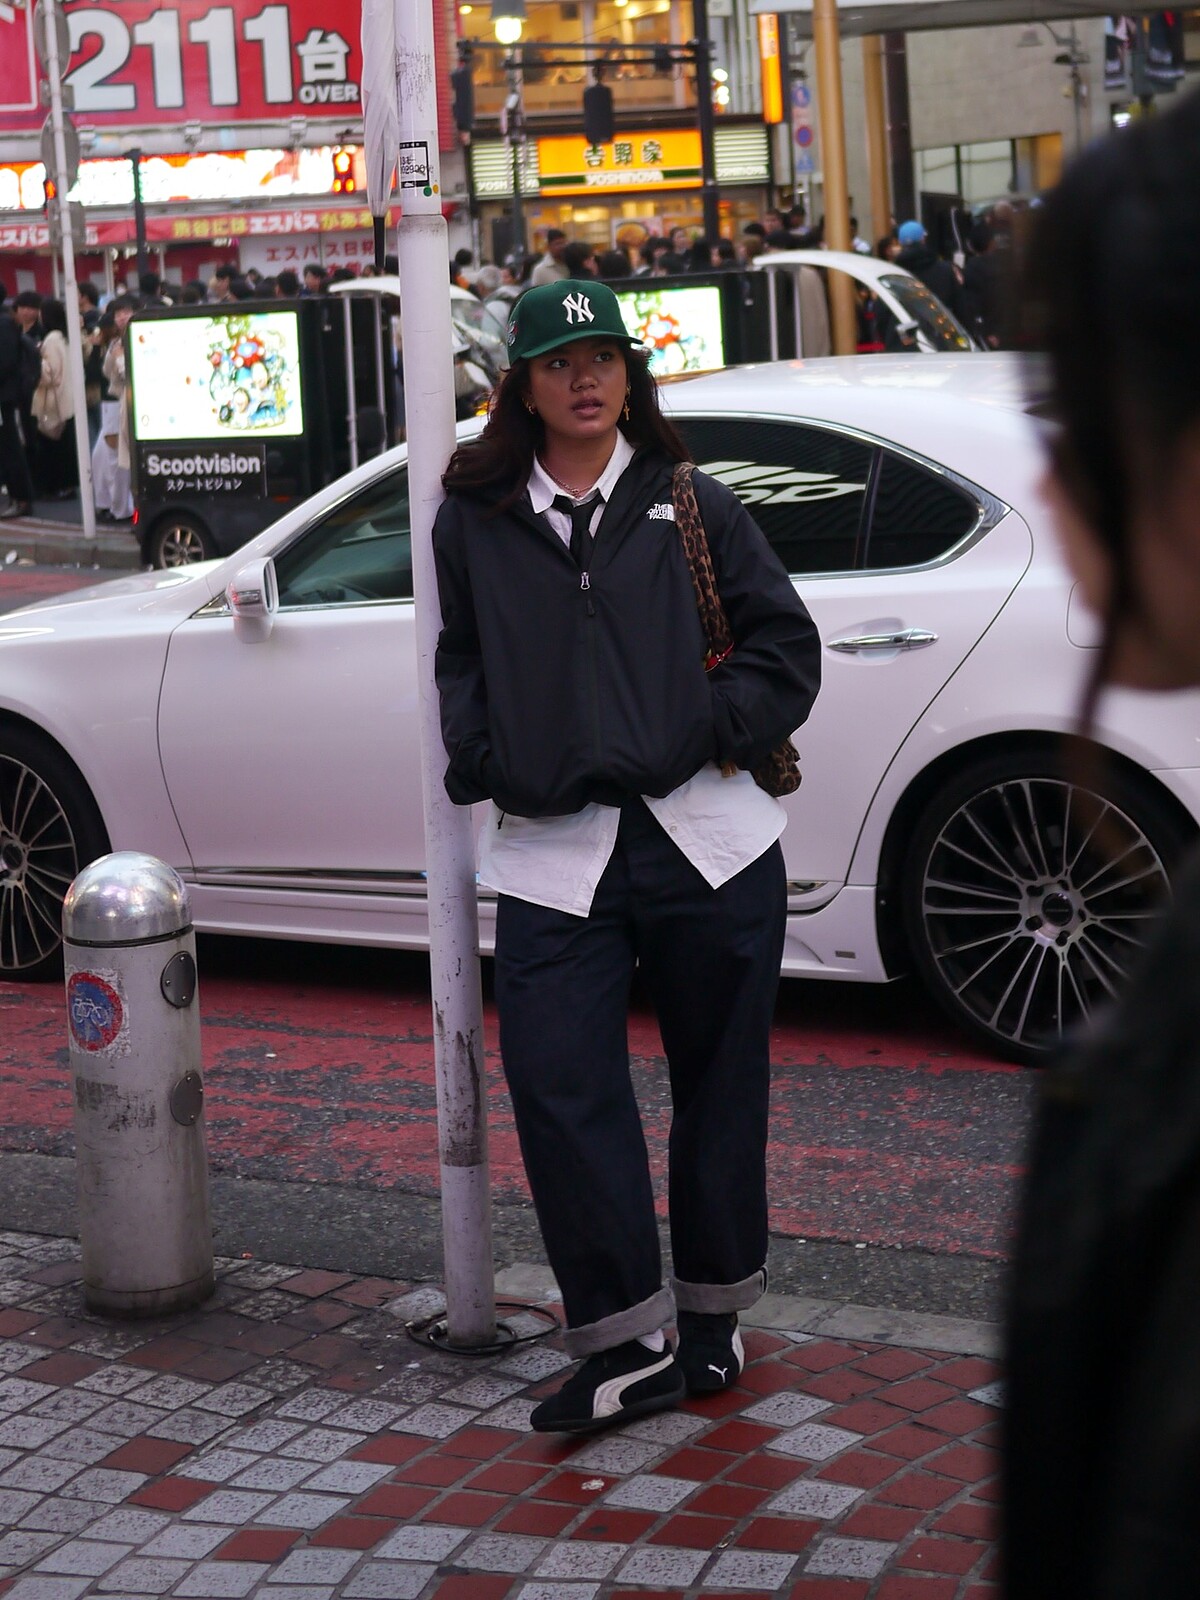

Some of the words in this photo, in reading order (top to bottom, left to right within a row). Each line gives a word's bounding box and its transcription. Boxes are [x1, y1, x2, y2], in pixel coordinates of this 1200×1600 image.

[299, 83, 358, 104] OVER
[585, 141, 664, 168] 吉野家
[562, 292, 595, 325] NY
[147, 452, 261, 476] Scootvision
